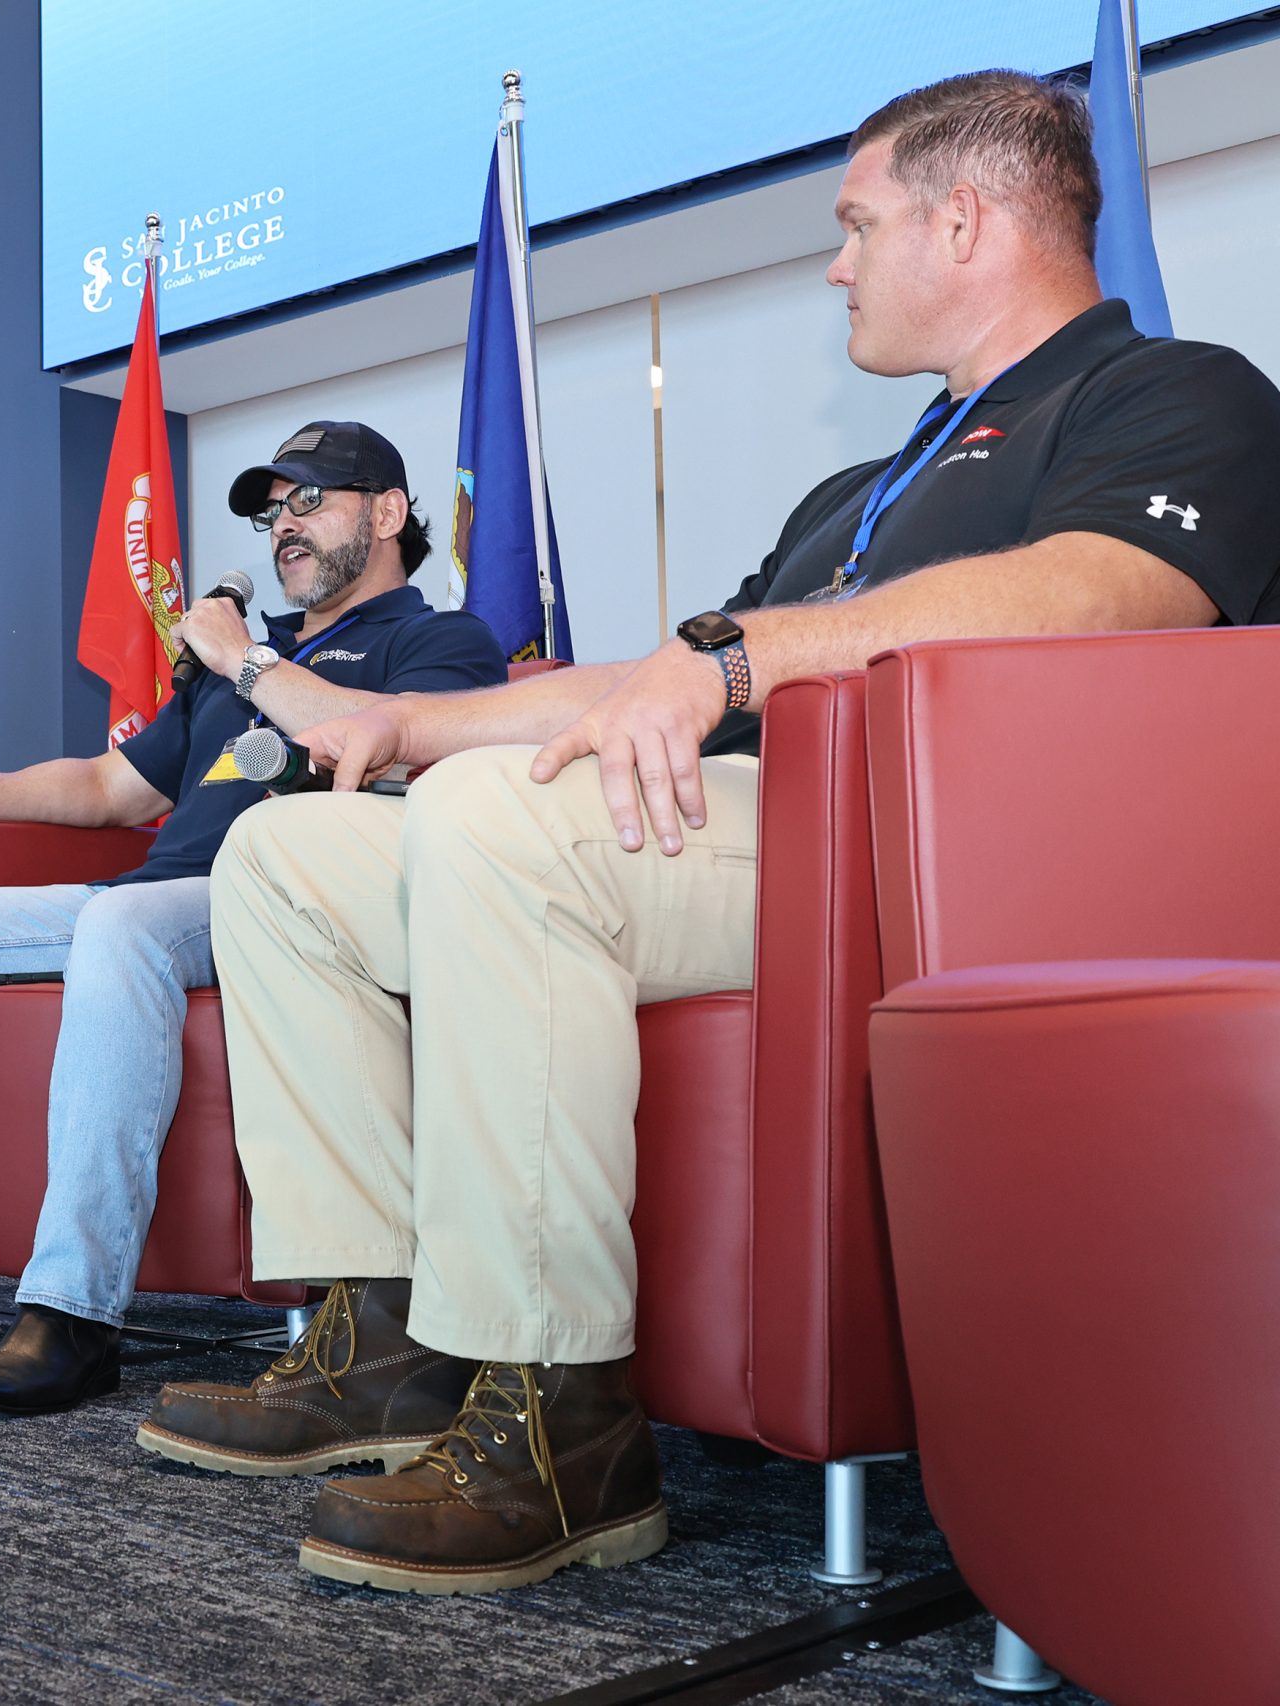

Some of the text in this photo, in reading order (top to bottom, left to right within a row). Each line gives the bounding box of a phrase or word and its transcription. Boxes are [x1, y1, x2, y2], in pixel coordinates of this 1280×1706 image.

[121, 186, 286, 260] SA JACINTO
[198, 265, 222, 281] Your
[224, 253, 266, 272] College.
[969, 449, 990, 459] Hub
[127, 519, 154, 606] UNITE
